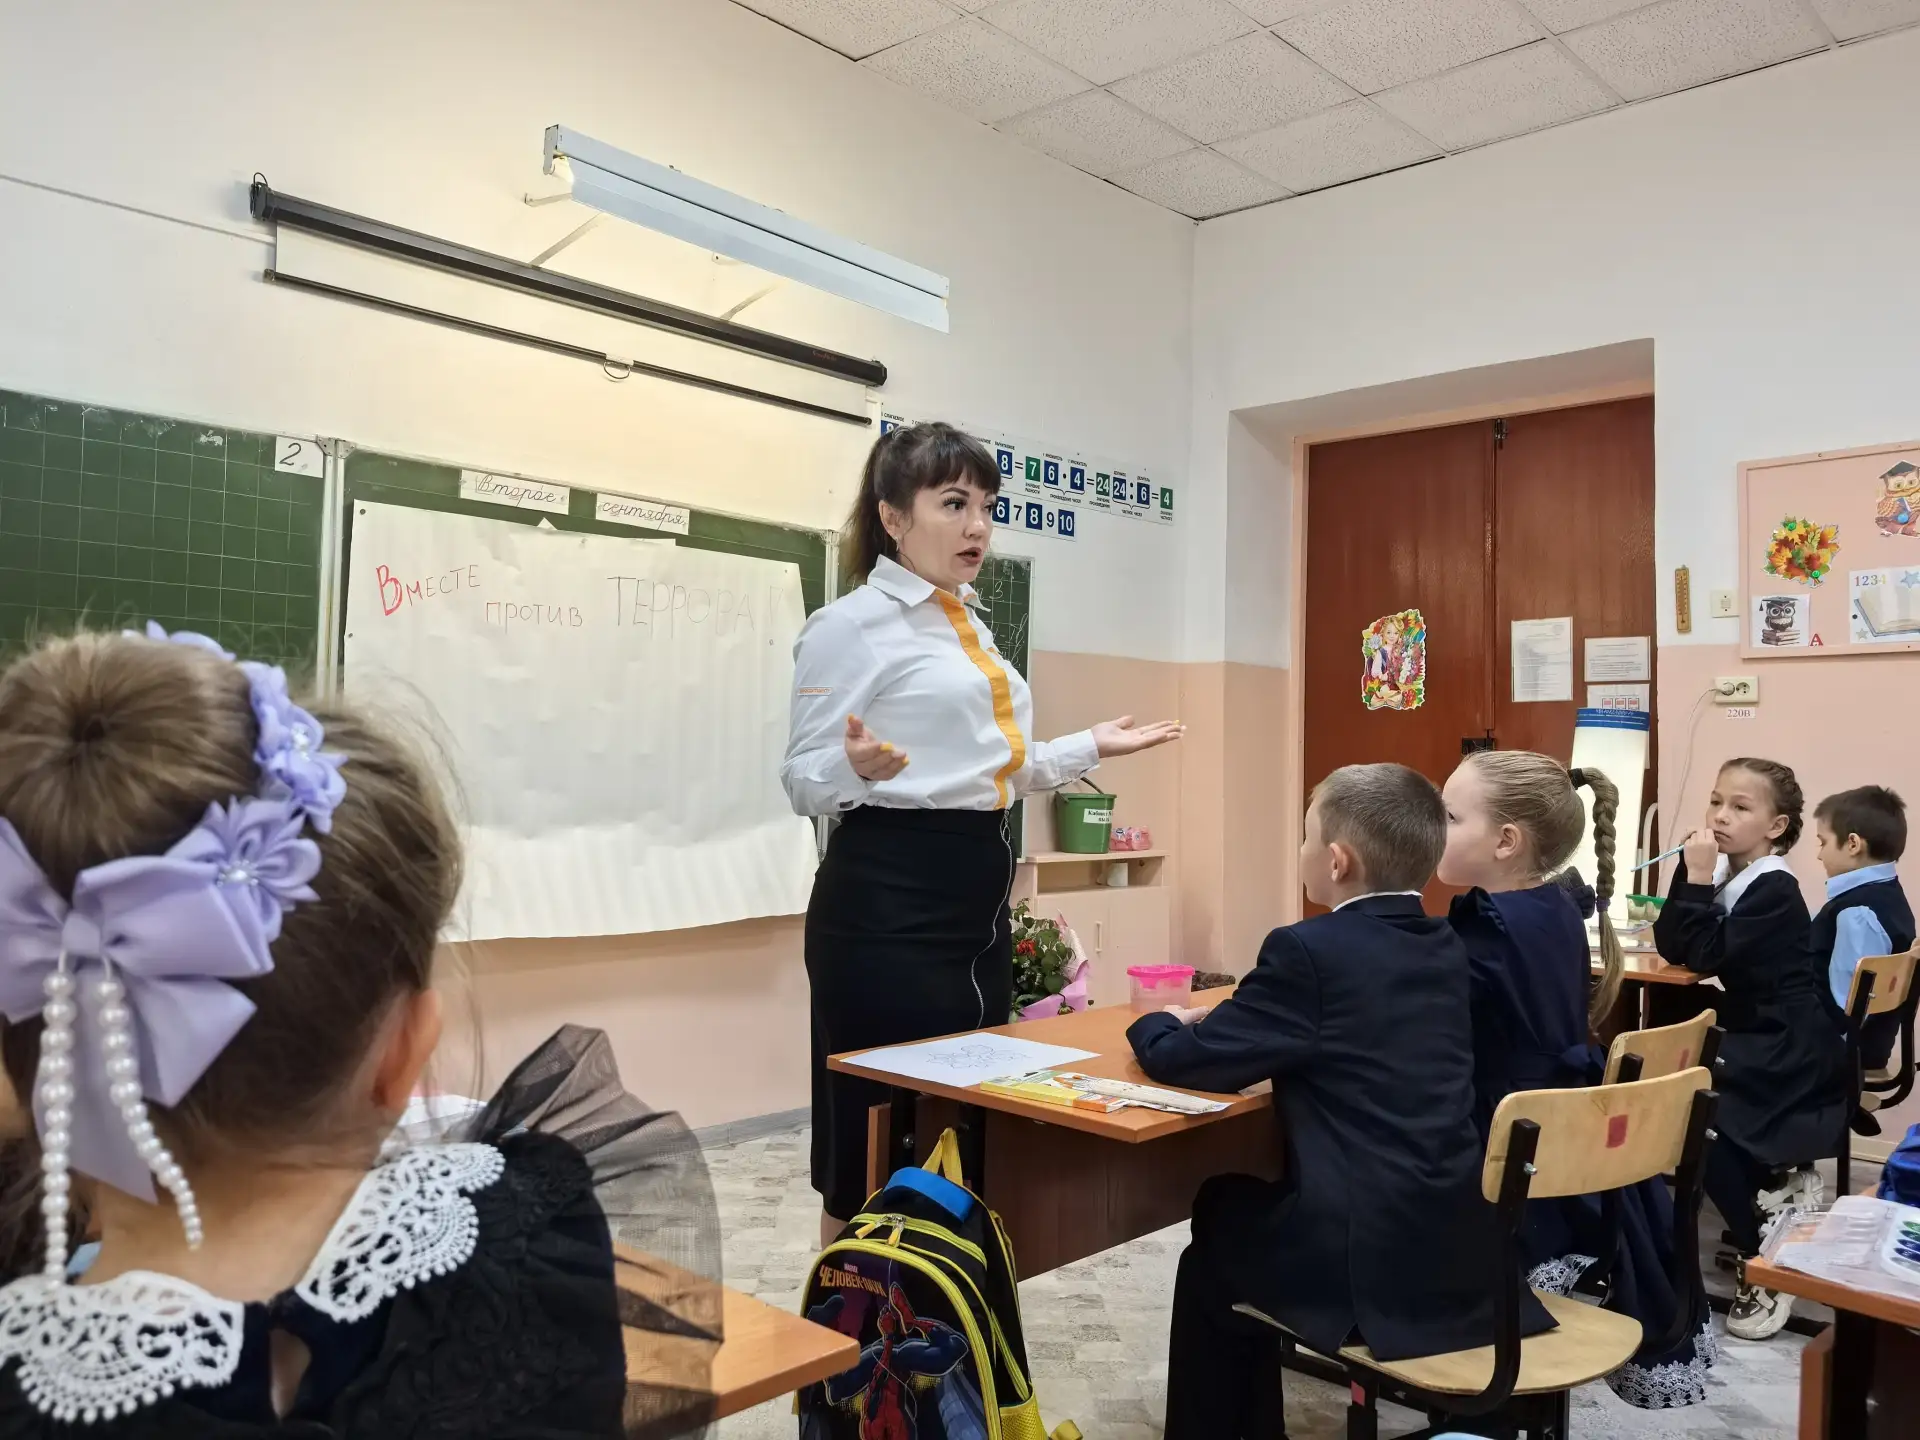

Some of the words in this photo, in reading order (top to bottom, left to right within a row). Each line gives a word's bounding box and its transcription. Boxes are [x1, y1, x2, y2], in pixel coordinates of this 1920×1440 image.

[279, 442, 301, 466] 2
[1001, 454, 1009, 471] 8
[1029, 461, 1037, 477] 7
[1048, 465, 1055, 481] 6
[1073, 472, 1081, 487] 4
[1097, 477, 1110, 493] 24
[1113, 481, 1126, 498] 24
[1140, 486, 1147, 501] 6
[1163, 492, 1170, 506] 4
[996, 501, 1005, 518] 6
[1013, 504, 1022, 521] 7
[1030, 508, 1039, 525] 8
[1046, 511, 1055, 528] 9
[1060, 514, 1073, 532] 10
